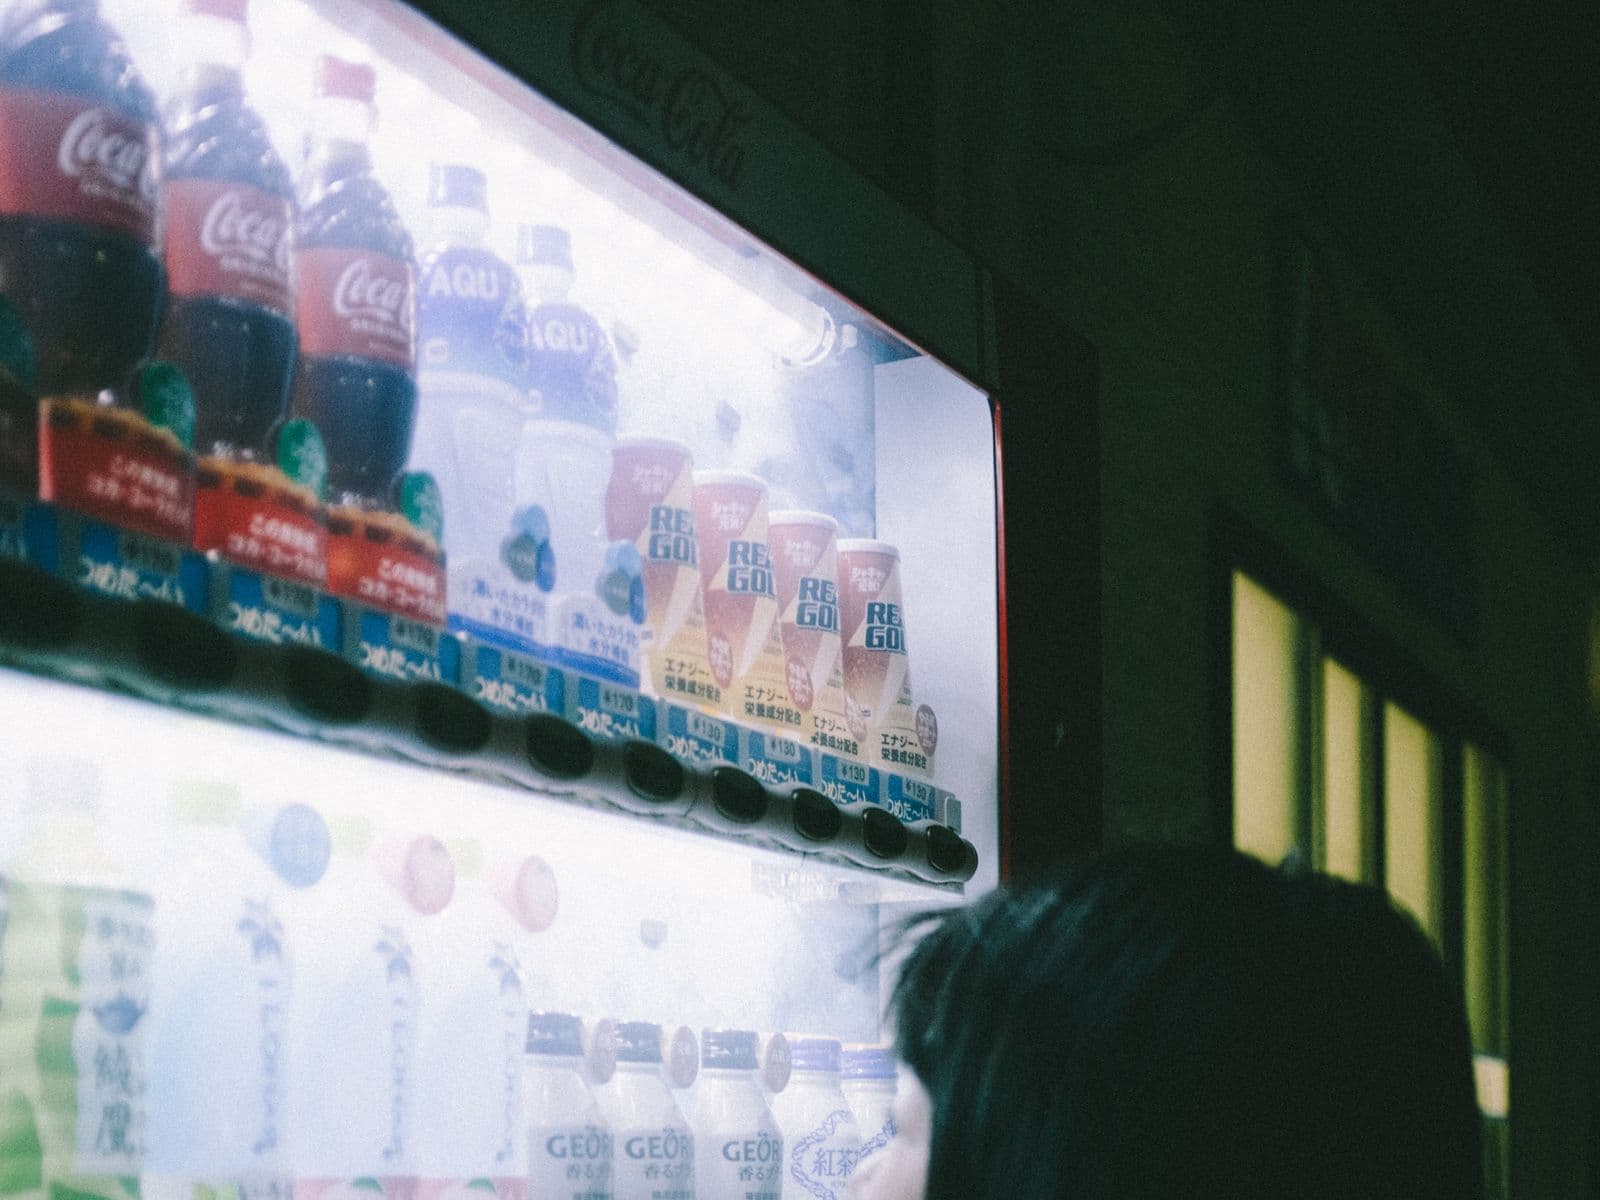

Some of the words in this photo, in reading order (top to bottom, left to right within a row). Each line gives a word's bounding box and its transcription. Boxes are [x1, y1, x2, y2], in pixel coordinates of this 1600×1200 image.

[428, 264, 499, 298] AQU
[693, 719, 721, 742] ¥130
[770, 738, 796, 757] ¥130
[842, 765, 865, 783] ¥130
